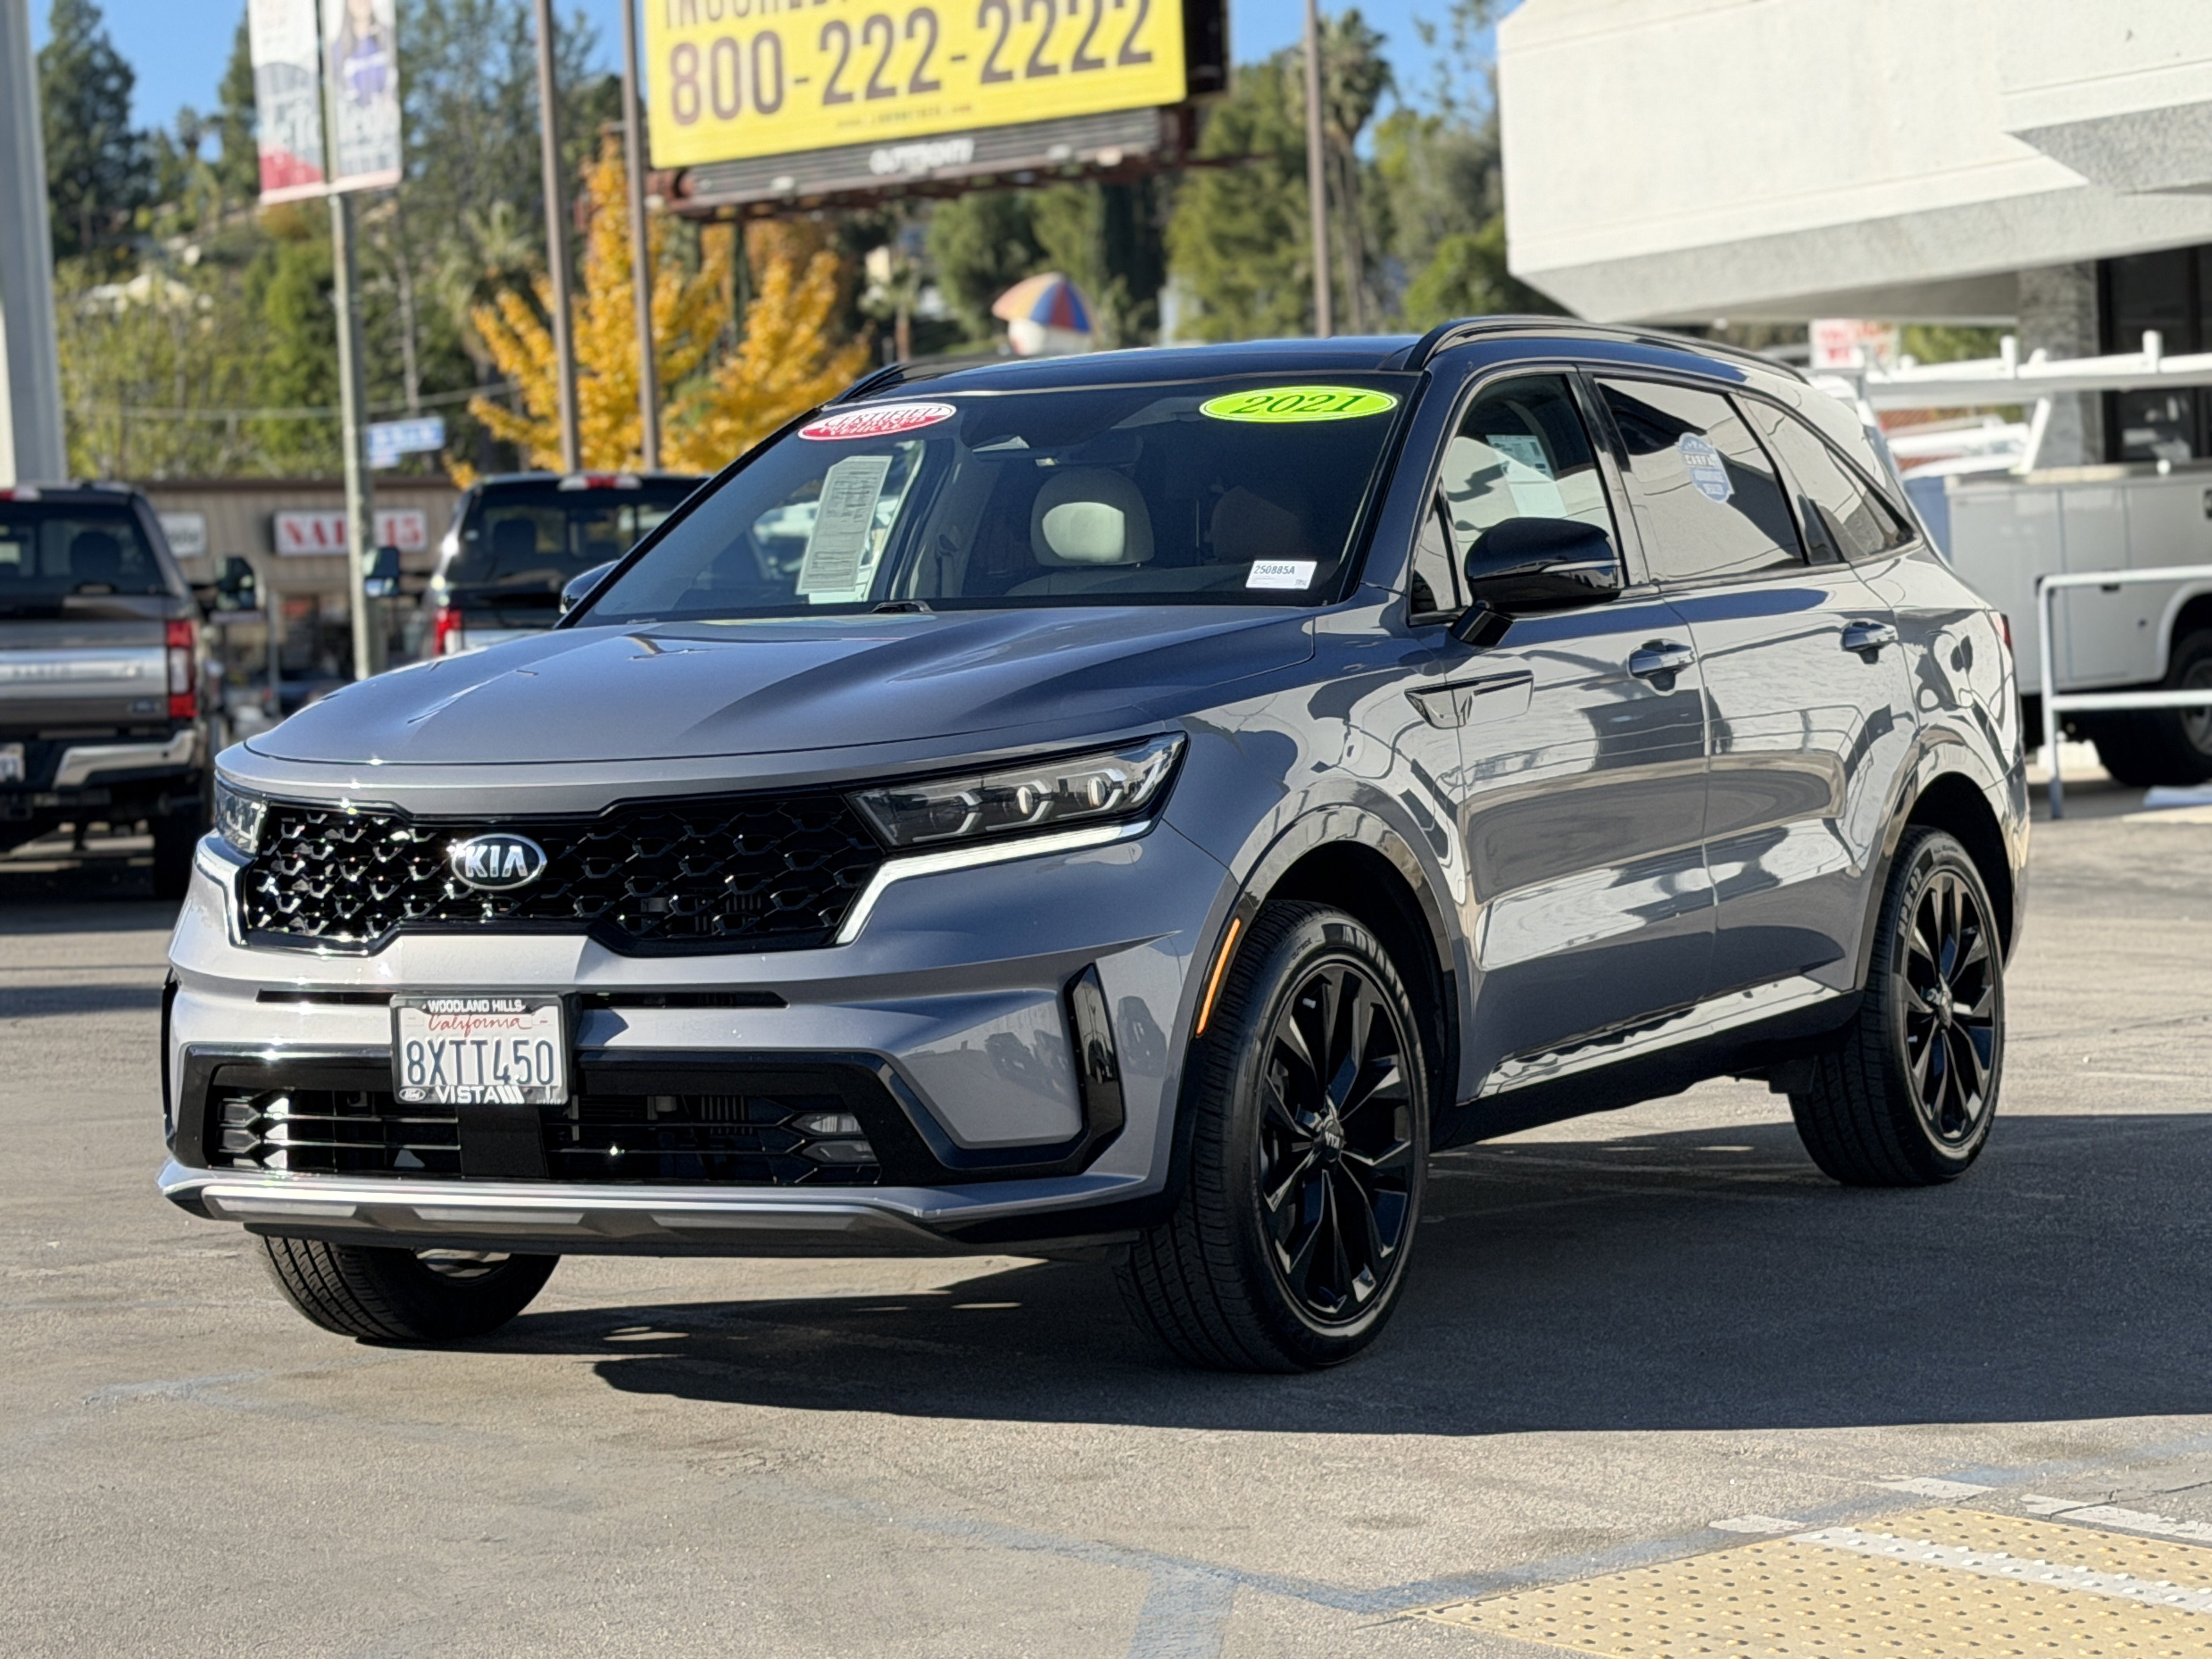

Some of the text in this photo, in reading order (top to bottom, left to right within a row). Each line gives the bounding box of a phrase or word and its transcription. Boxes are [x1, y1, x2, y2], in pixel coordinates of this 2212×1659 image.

[670, 0, 1152, 126] 800-222-2222
[1229, 394, 1367, 415] 2021
[465, 845, 528, 878] KIA
[427, 1000, 523, 1012] WOODLAND HILLS
[428, 1014, 532, 1037] California
[407, 1039, 554, 1086] 8XTT450
[435, 1086, 500, 1104] VISTA
